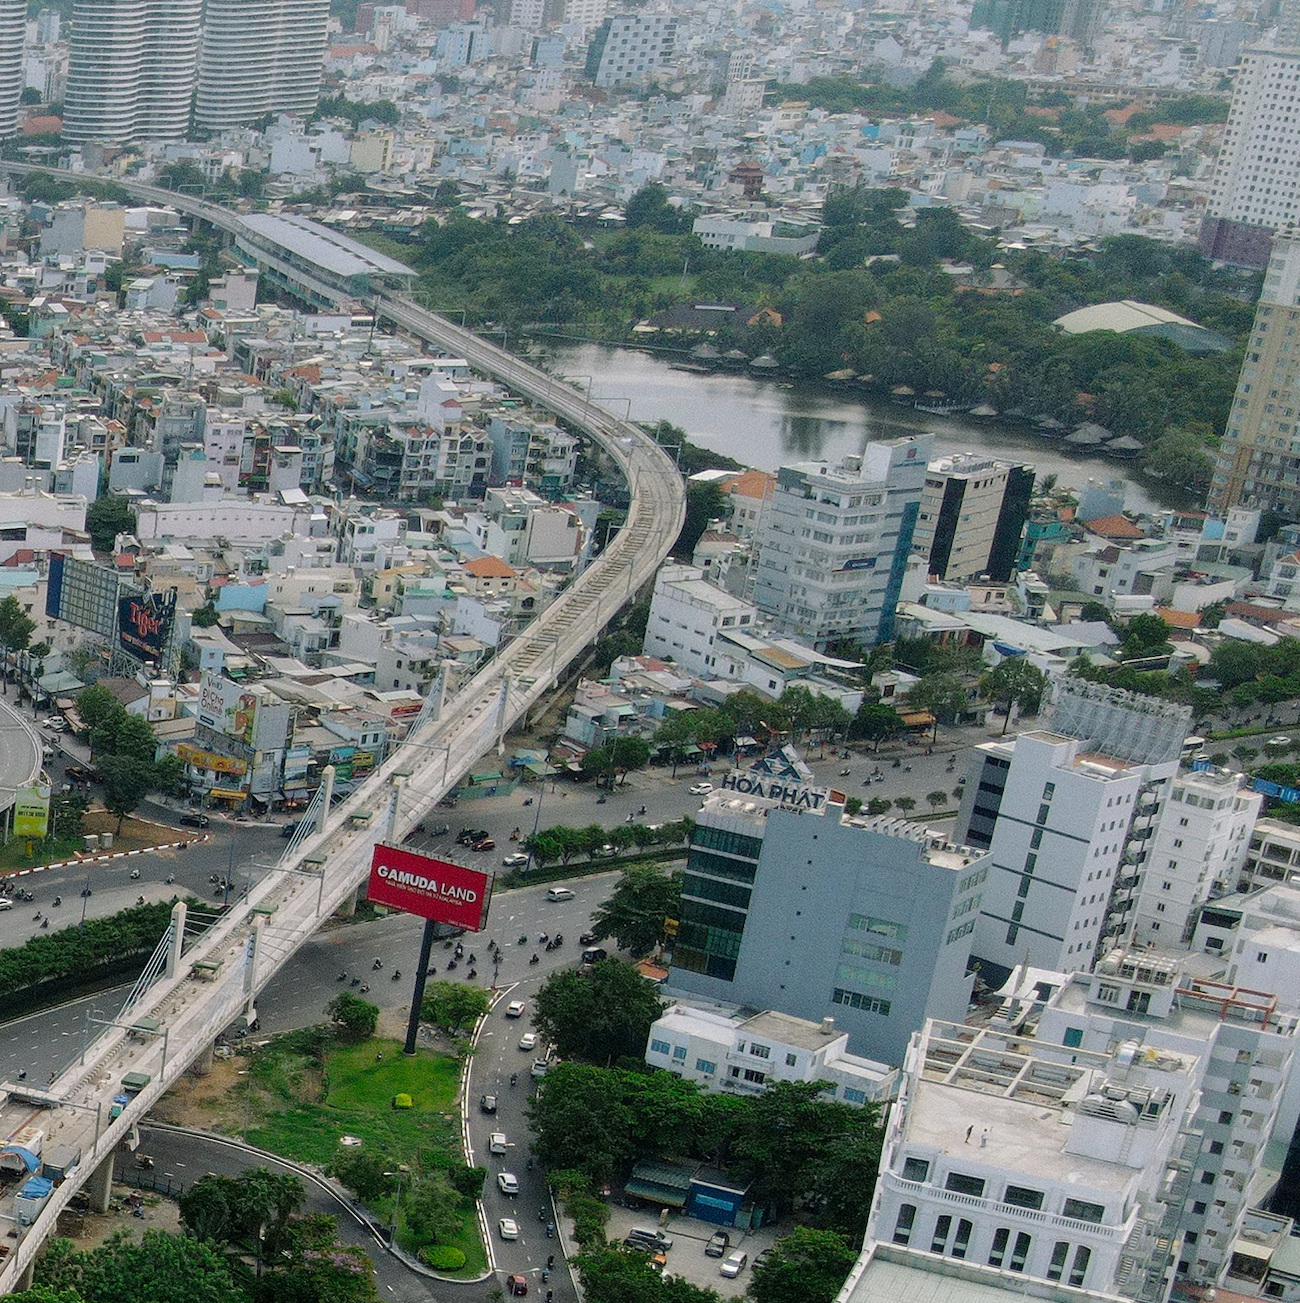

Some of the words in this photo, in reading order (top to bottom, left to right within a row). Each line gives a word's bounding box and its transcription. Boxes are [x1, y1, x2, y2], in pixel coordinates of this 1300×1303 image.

[722, 773, 765, 798] HOA
[376, 865, 437, 892] GAMUDA
[441, 882, 477, 903] LAND
